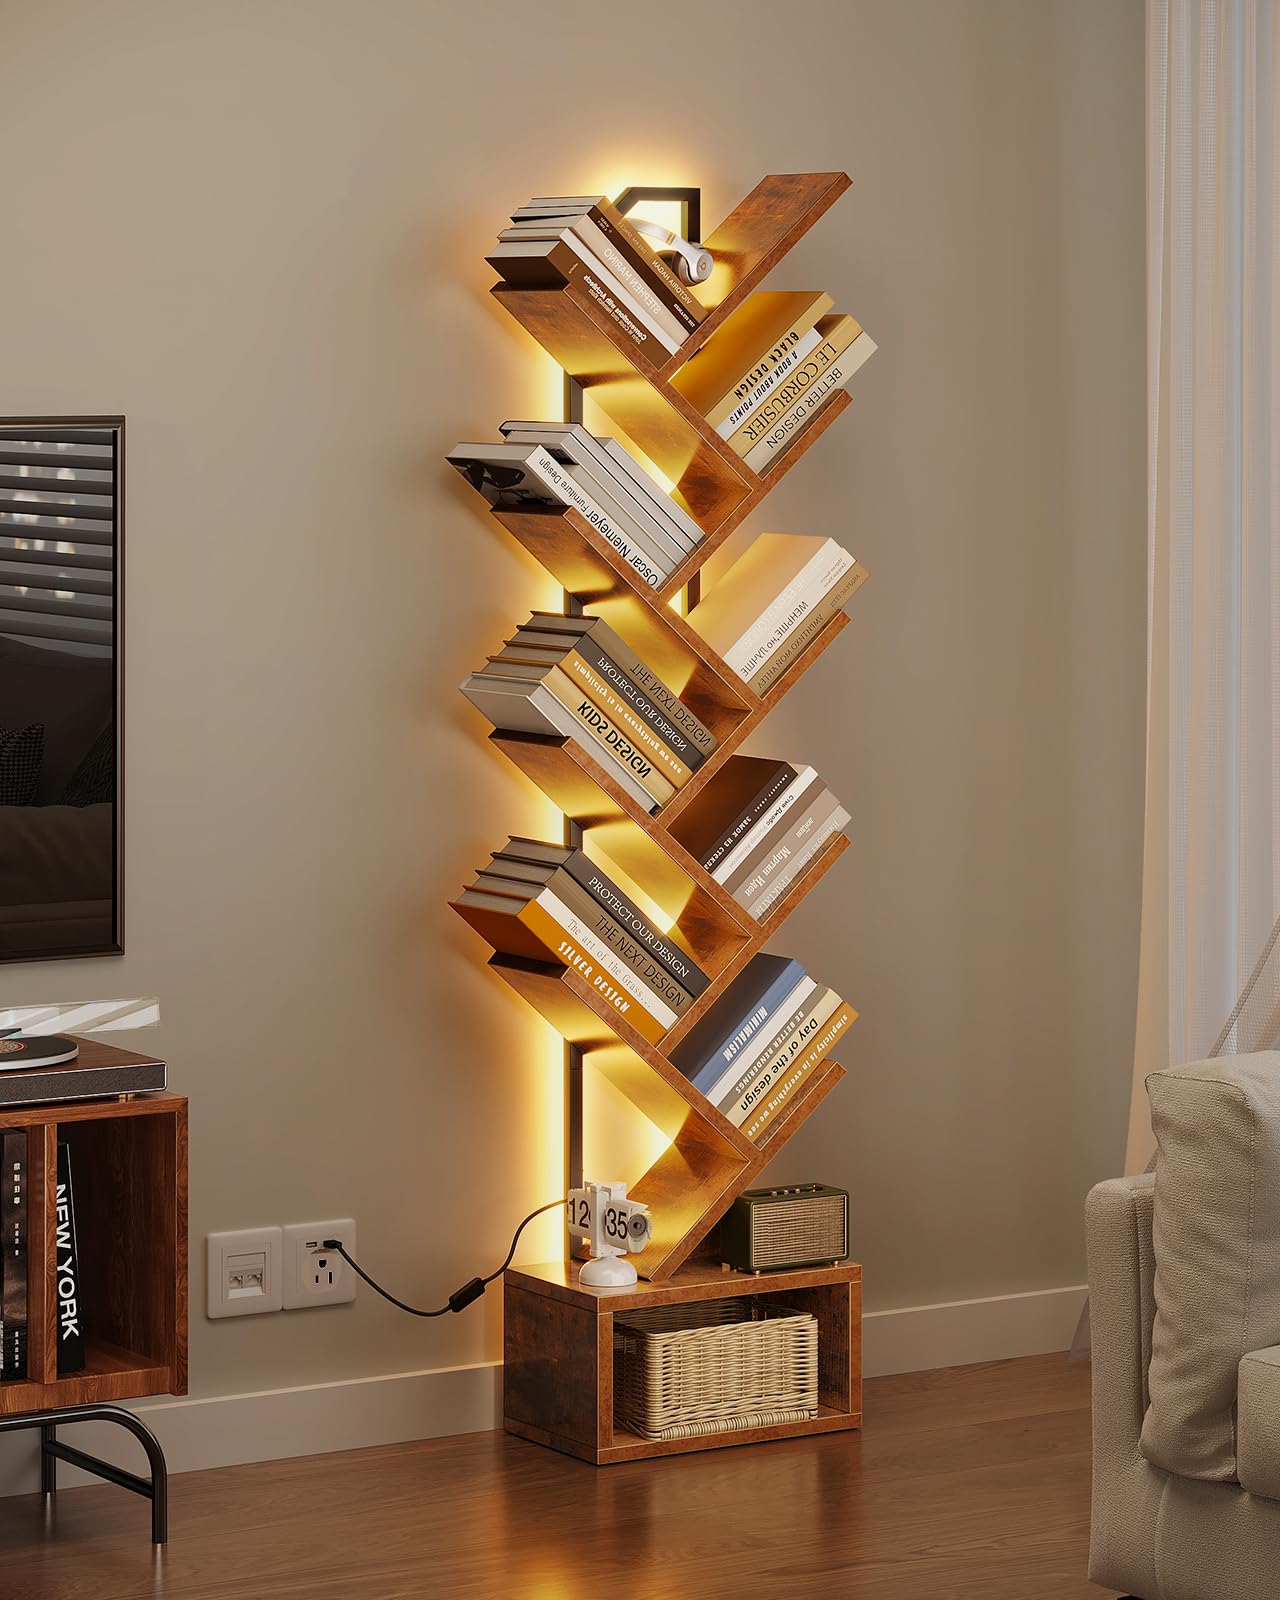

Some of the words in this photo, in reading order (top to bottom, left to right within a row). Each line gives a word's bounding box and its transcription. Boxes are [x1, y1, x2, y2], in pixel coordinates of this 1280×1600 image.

[768, 332, 799, 363] BLACK
[791, 351, 797, 359] A
[815, 342, 837, 366] LE
[734, 363, 769, 400] DESIGN
[774, 357, 792, 378] BOOK
[743, 363, 818, 440] CORBUSIER
[753, 376, 774, 400] ABOUT
[805, 368, 843, 407] BETTER
[730, 398, 753, 424] POINTS
[766, 406, 807, 449] DESIGN
[539, 458, 562, 484] Design
[561, 481, 589, 512] Furniture
[585, 511, 631, 557] Niemeyer
[629, 555, 658, 587] Oscar
[762, 846, 791, 876] Мартин
[745, 875, 766, 896] Иден
[588, 877, 634, 921] PROTECT
[632, 920, 654, 944] OUR
[652, 940, 689, 977] DESIGN
[567, 919, 581, 935] The
[582, 936, 595, 950] art
[597, 951, 609, 961] of
[608, 961, 621, 975] the
[595, 915, 619, 941] THE
[615, 937, 647, 967] NEXT
[643, 964, 685, 1007] DESIGN
[558, 941, 593, 978] SILVER
[594, 976, 630, 1013] DESIGN
[795, 1011, 804, 1022] BE
[798, 1018, 818, 1041] Day
[723, 1006, 768, 1061] MINIMALISM
[773, 1021, 795, 1048] BETTER
[788, 1041, 798, 1057] of
[817, 1015, 847, 1053] simplicity
[735, 1047, 774, 1093] RENDERINGS
[771, 1054, 788, 1073] the
[802, 1060, 811, 1070] in
[810, 1052, 818, 1061] is
[741, 1074, 771, 1111] design
[768, 1070, 802, 1111] everything
[748, 1122, 759, 1136] see
[759, 1110, 770, 1122] we
[56, 1184, 71, 1249] NEW
[569, 1198, 589, 1229] 12
[606, 1208, 628, 1239] 35
[56, 1256, 79, 1340] YORK
